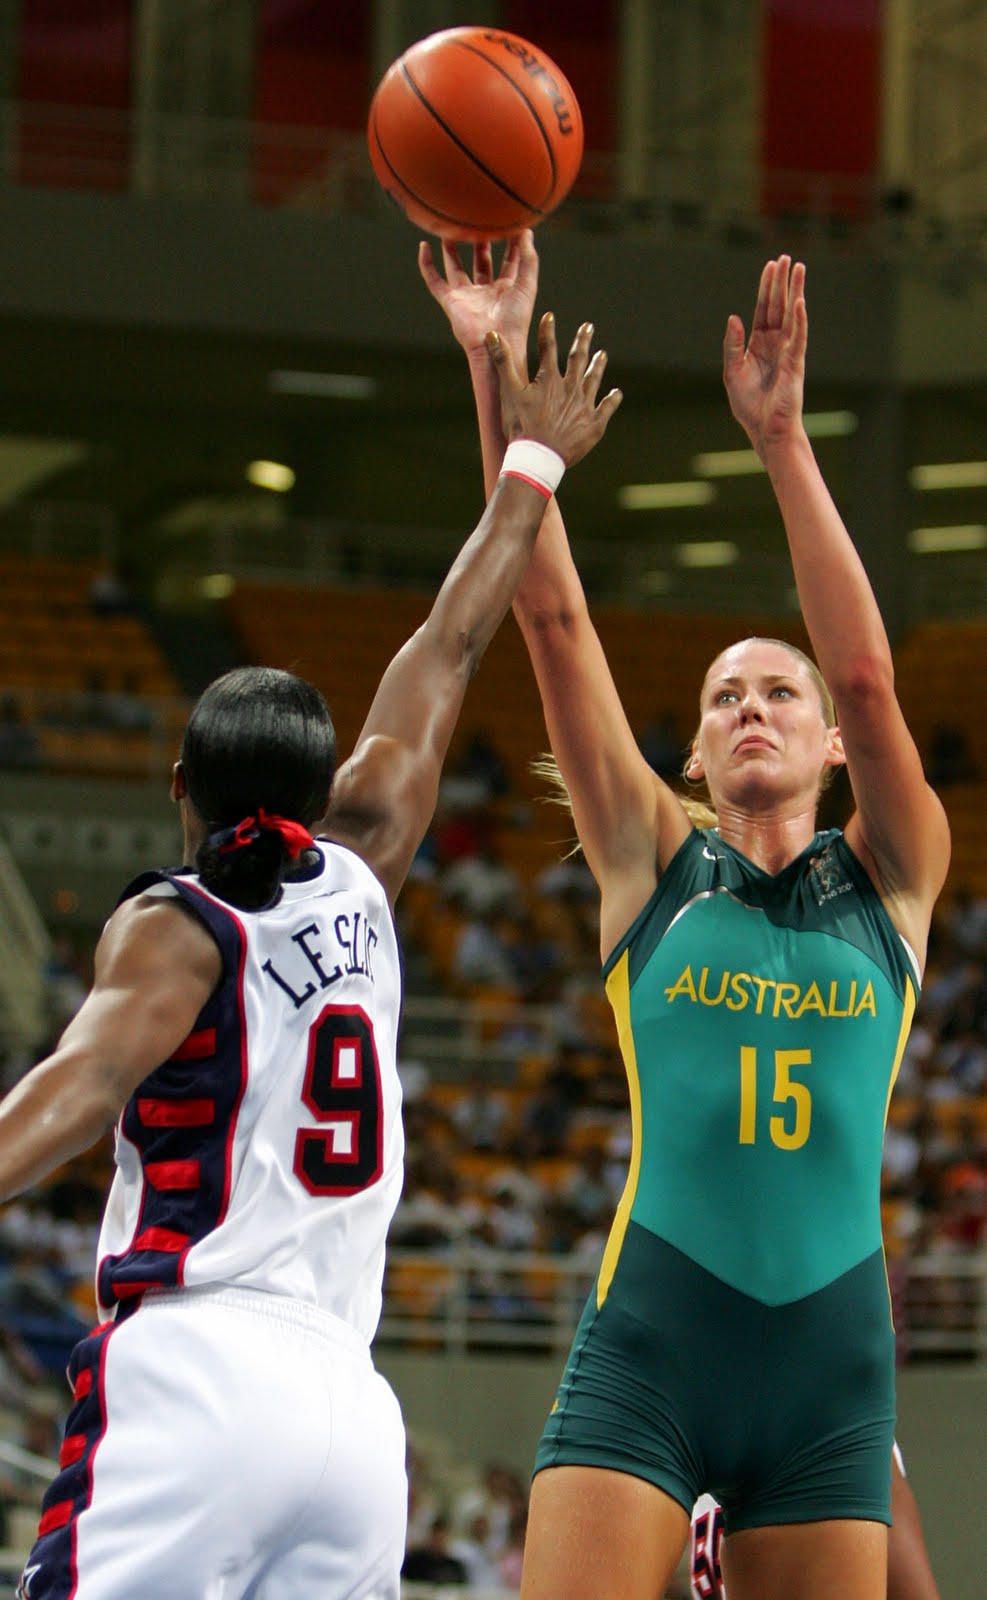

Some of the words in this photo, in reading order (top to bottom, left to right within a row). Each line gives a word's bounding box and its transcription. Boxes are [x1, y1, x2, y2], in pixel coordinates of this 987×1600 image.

[664, 964, 876, 1018] AUSTRALIA
[293, 1003, 384, 1197] 9
[739, 1046, 812, 1150] 15
